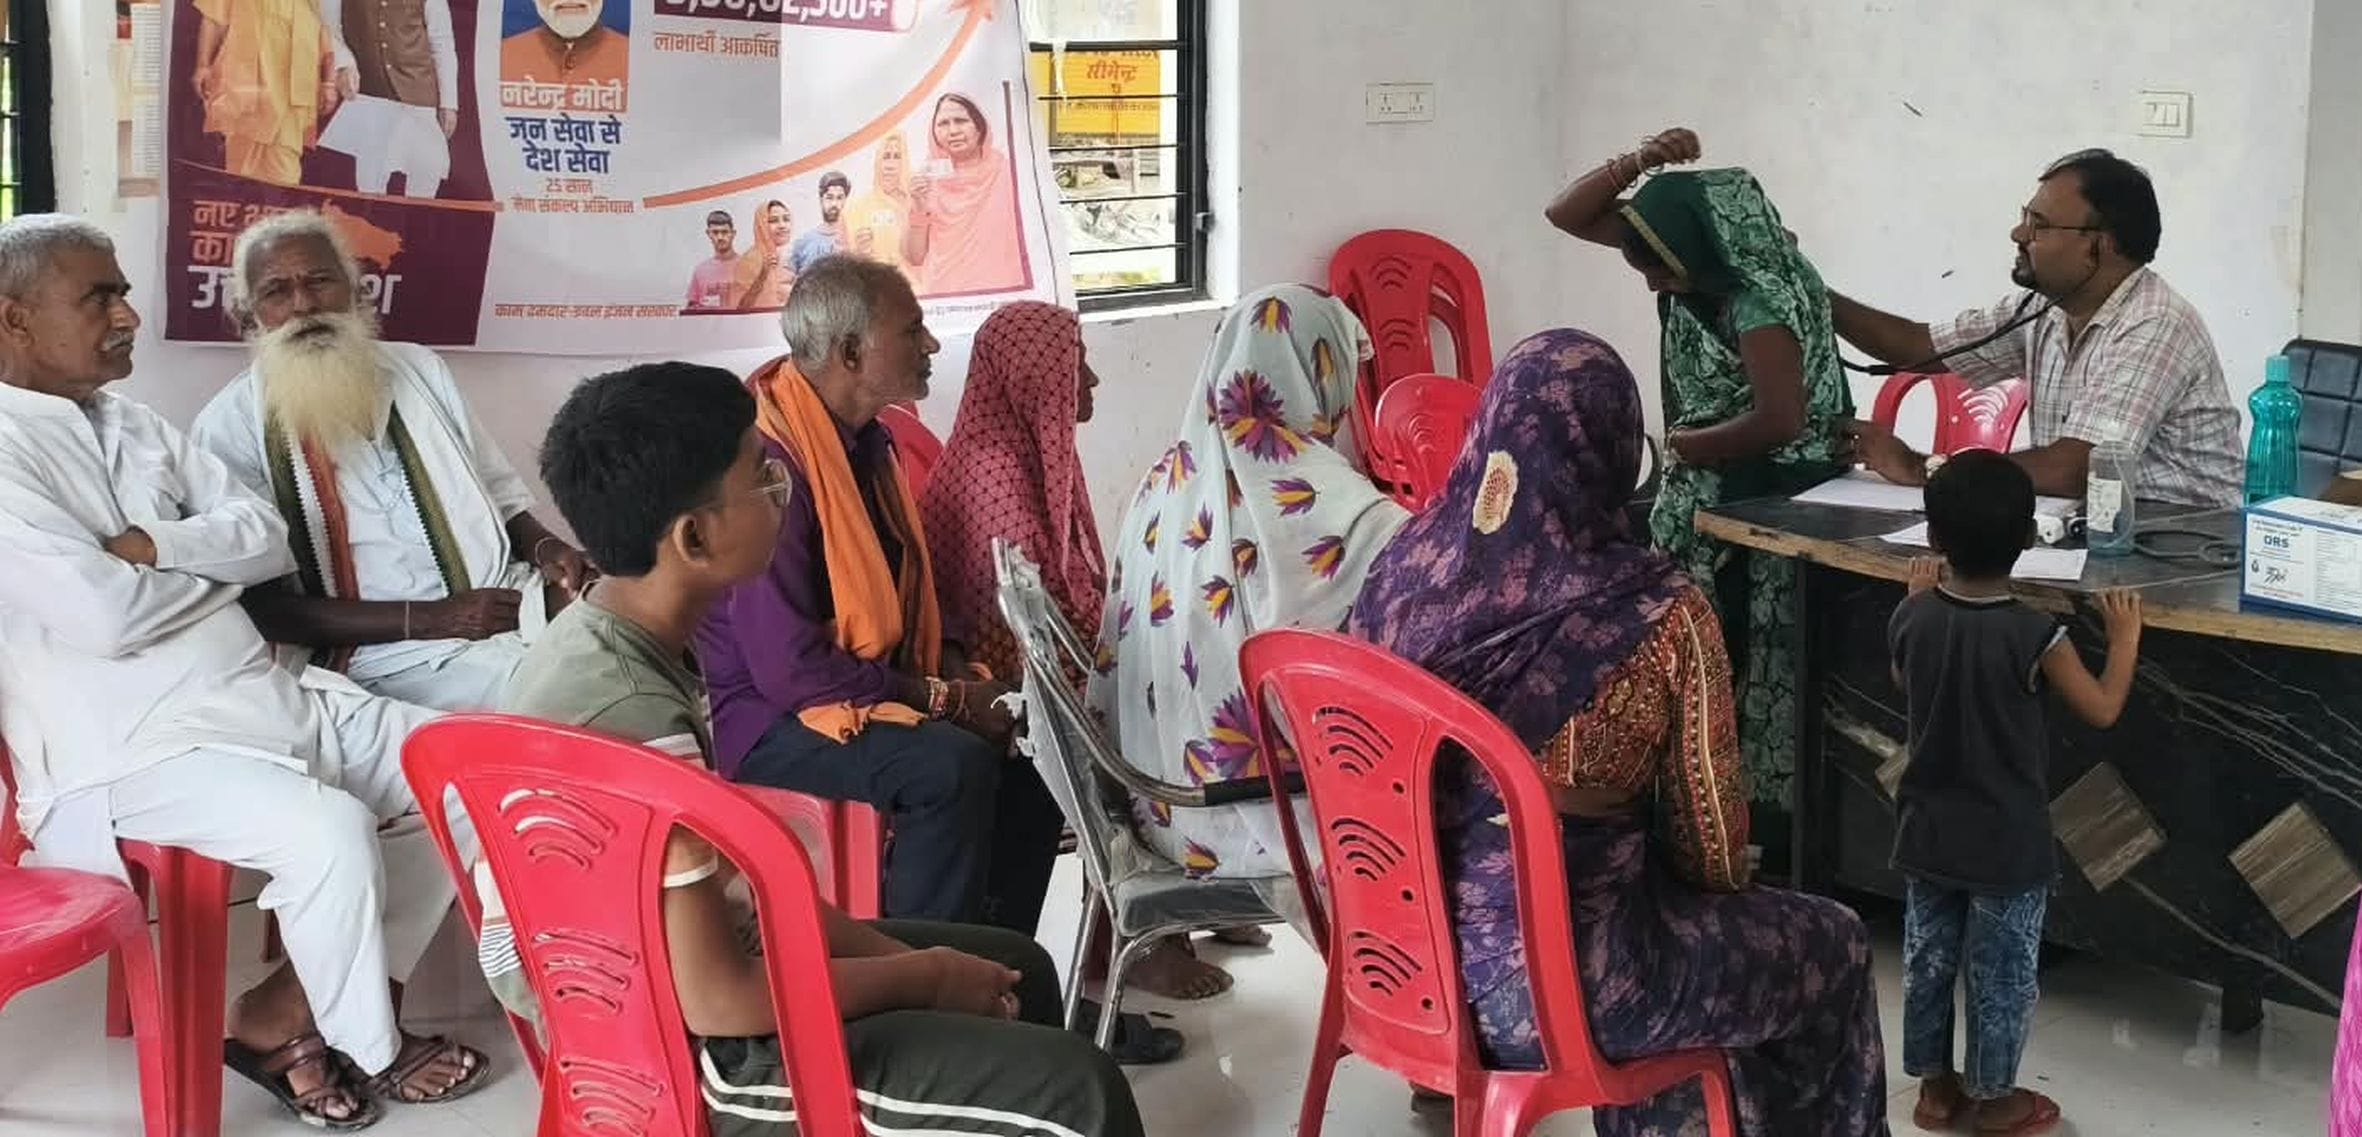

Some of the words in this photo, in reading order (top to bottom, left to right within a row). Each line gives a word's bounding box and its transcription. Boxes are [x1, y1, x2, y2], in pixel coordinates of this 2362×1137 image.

[500, 76, 566, 110] नरेन्द्र
[572, 78, 624, 110] मोदी
[505, 116, 547, 141] जन
[550, 112, 595, 144] सेवा
[598, 115, 622, 144] से
[522, 140, 562, 172] देश
[564, 142, 610, 174] सेवा
[193, 200, 242, 227] नए
[2264, 535, 2290, 548] ORS
